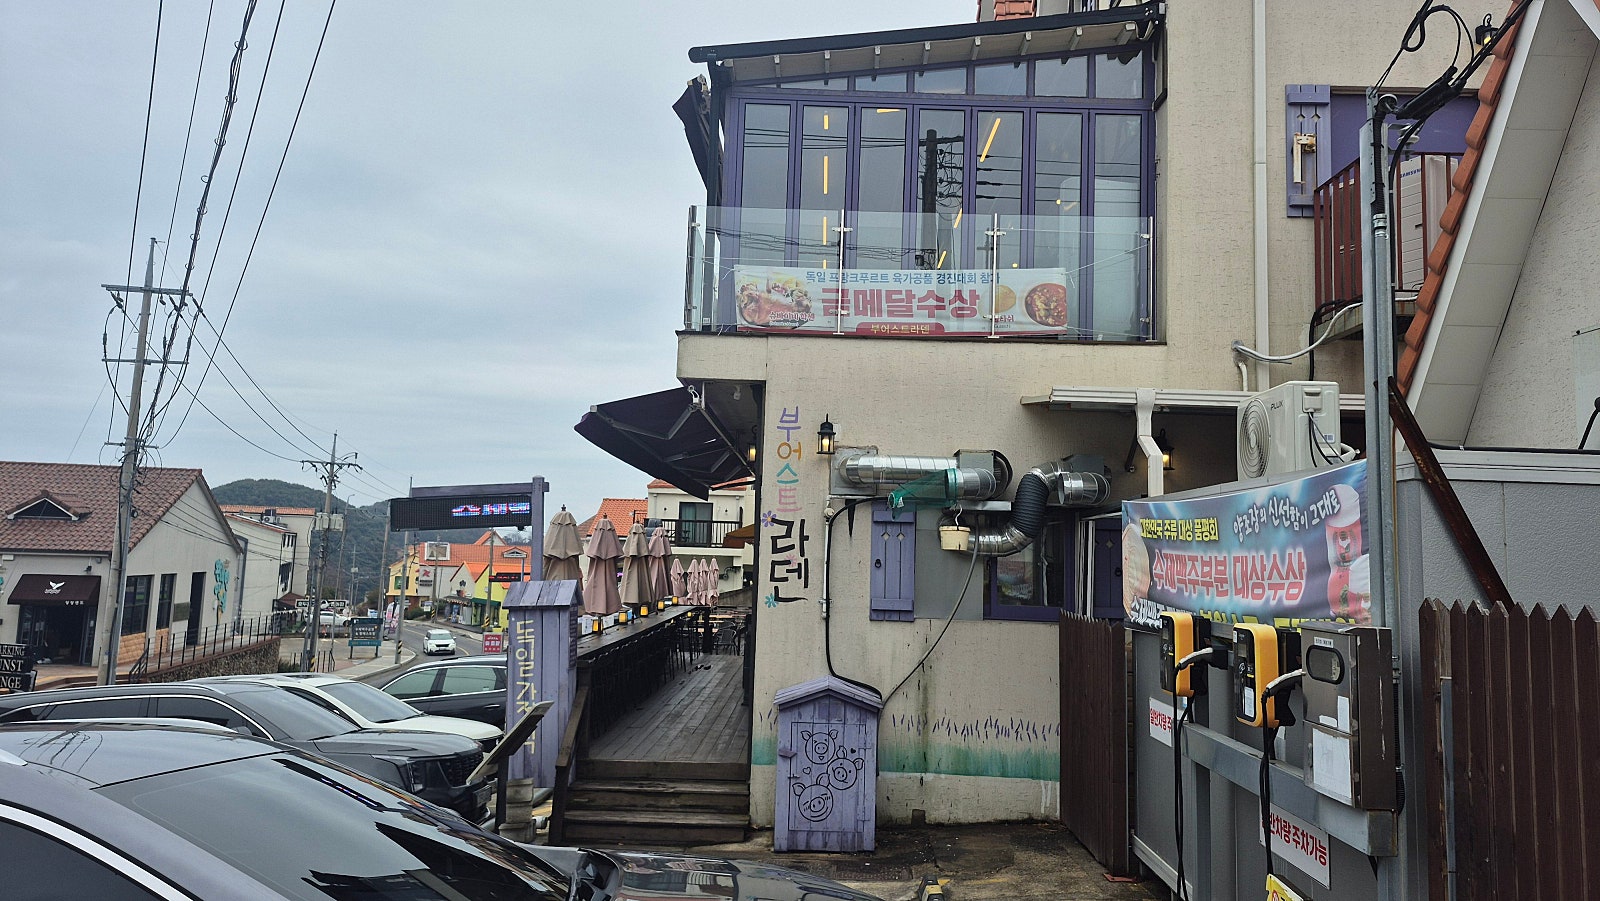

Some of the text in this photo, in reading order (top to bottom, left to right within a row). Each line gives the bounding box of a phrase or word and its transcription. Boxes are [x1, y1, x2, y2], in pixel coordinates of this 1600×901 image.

[806, 271, 826, 283] 독일
[829, 271, 889, 284] 프랑크푸르트
[892, 272, 933, 284] 육가공품
[936, 272, 977, 285] 경진대회
[821, 288, 980, 319] 금메달수상
[870, 323, 930, 334] 부어스트라덴
[1140, 517, 1219, 541] 대한민국 주류 대상 품평회
[1233, 489, 1340, 543] 양조장의 신선함이 그대로
[1153, 551, 1306, 601] 수제맥주부분 대상수상
[1262, 812, 1327, 867] 반차량 주차가능
